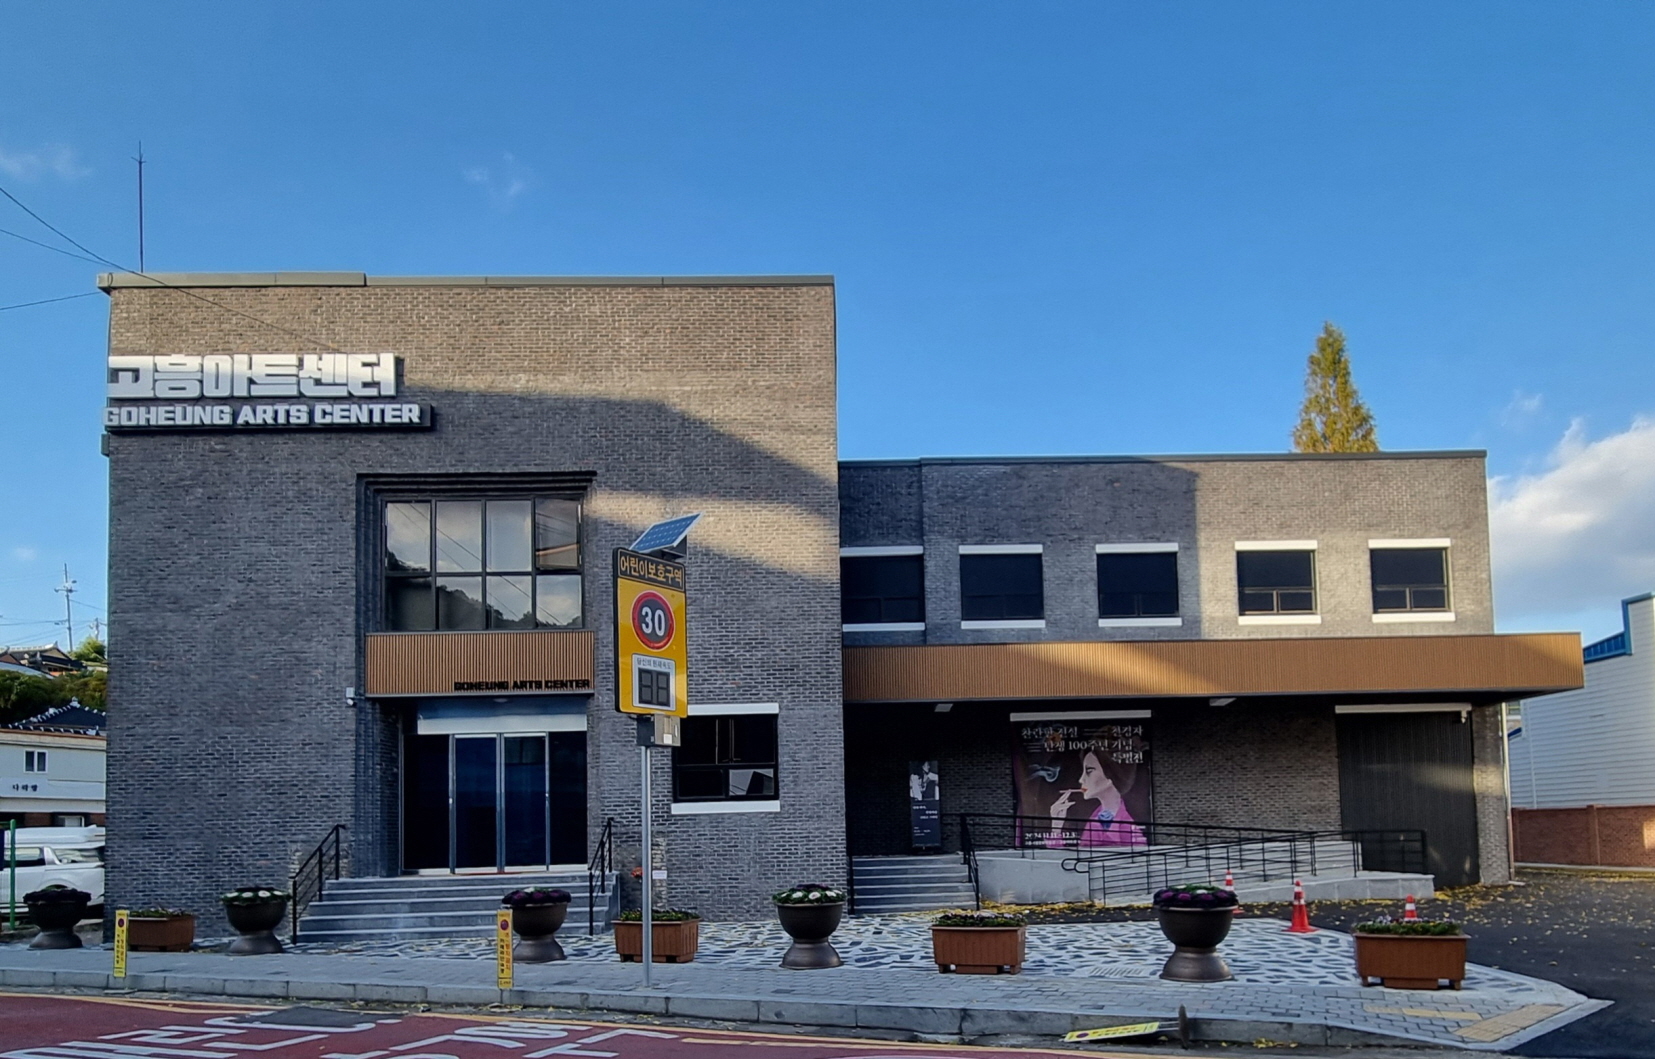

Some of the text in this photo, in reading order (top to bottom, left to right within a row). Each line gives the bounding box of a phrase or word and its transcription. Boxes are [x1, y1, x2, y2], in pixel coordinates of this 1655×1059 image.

[107, 352, 397, 398] 고흥아트센터
[103, 403, 421, 427] GOHEUNG ARTS CENTER
[620, 556, 684, 588] 어린이보호구역
[641, 606, 666, 637] 30
[454, 679, 590, 691] GOHEUNG ARTS CENTER
